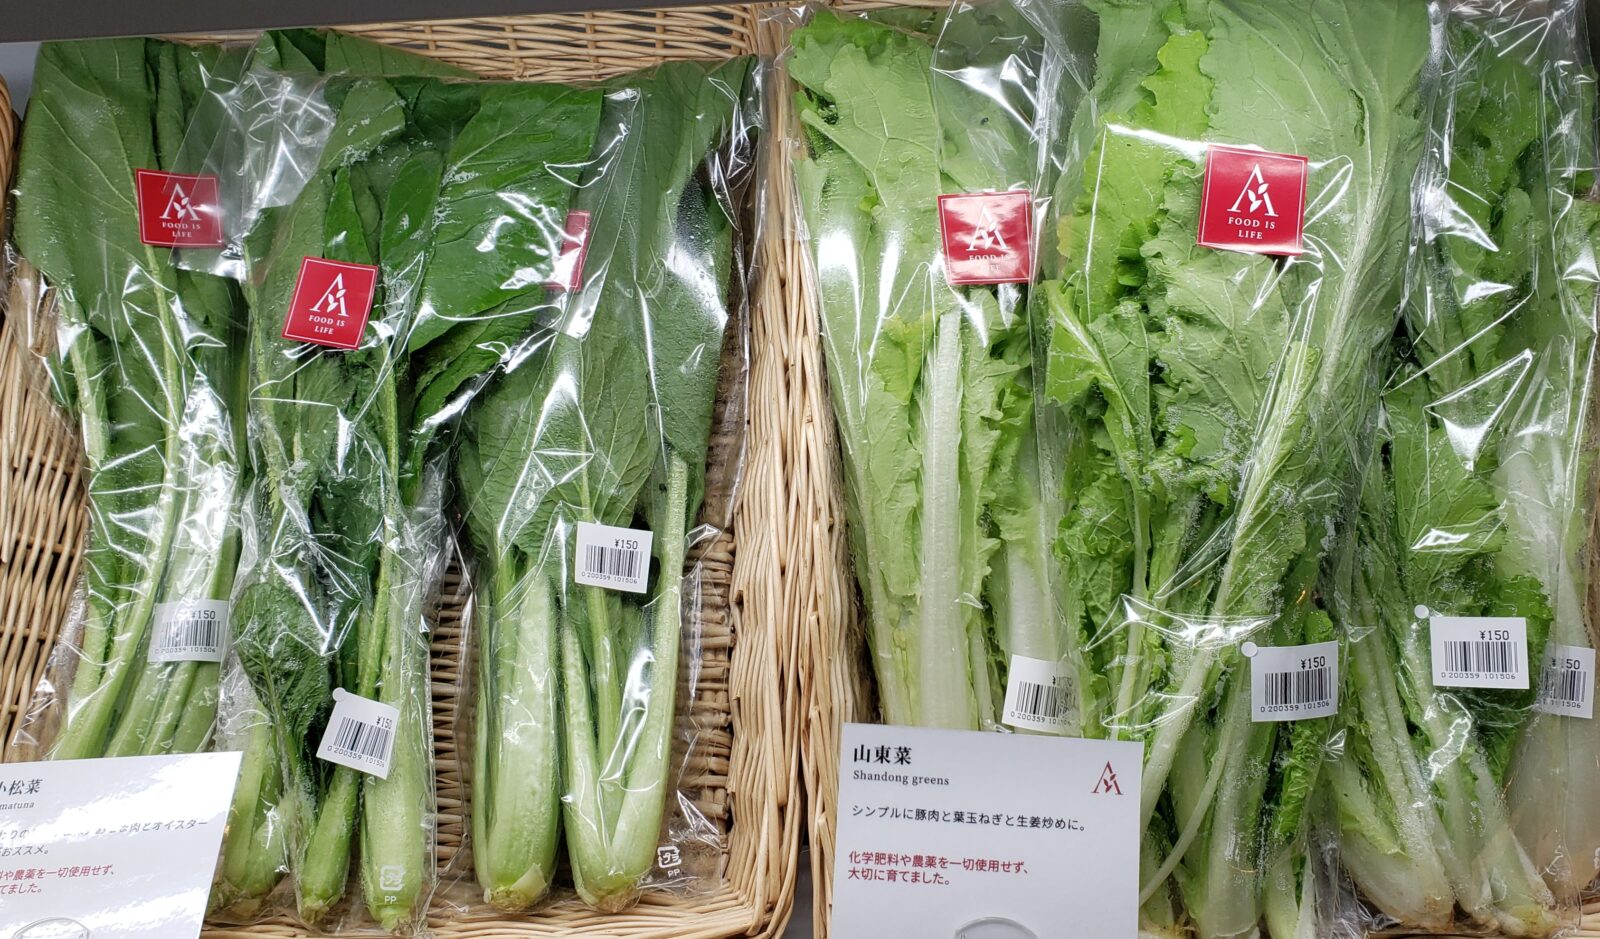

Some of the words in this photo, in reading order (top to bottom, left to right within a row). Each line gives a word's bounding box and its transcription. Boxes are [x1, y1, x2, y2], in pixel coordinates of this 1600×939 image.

[162, 221, 189, 229] FOOD
[1228, 216, 1260, 227] FOOD
[1265, 221, 1276, 229] IS
[172, 230, 193, 238] LIFE
[1238, 229, 1263, 239] LIFE
[969, 254, 997, 262] FOOD
[308, 314, 334, 325] FOOD
[336, 319, 346, 327] IS
[314, 325, 335, 335] LIFE
[614, 538, 638, 550] ¥150
[614, 576, 638, 584] 101506
[1479, 629, 1510, 641] ¥150
[1300, 655, 1326, 670] ¥150
[1268, 704, 1299, 712] 200359
[1303, 701, 1330, 710] 101506
[1017, 712, 1046, 723] 200359
[334, 747, 362, 760] 200359
[853, 744, 912, 765] 山東菜
[853, 769, 909, 785] Shandong
[911, 775, 950, 786] greens
[852, 804, 1085, 832] シンプルに豚肉と葉玉ねぎと生姜炒めに。
[848, 850, 1028, 874] 化学肥料や農薬を一切使用せず、
[667, 868, 681, 878] PP
[848, 866, 950, 886] 大切に育てました。
[384, 895, 397, 905] PP
